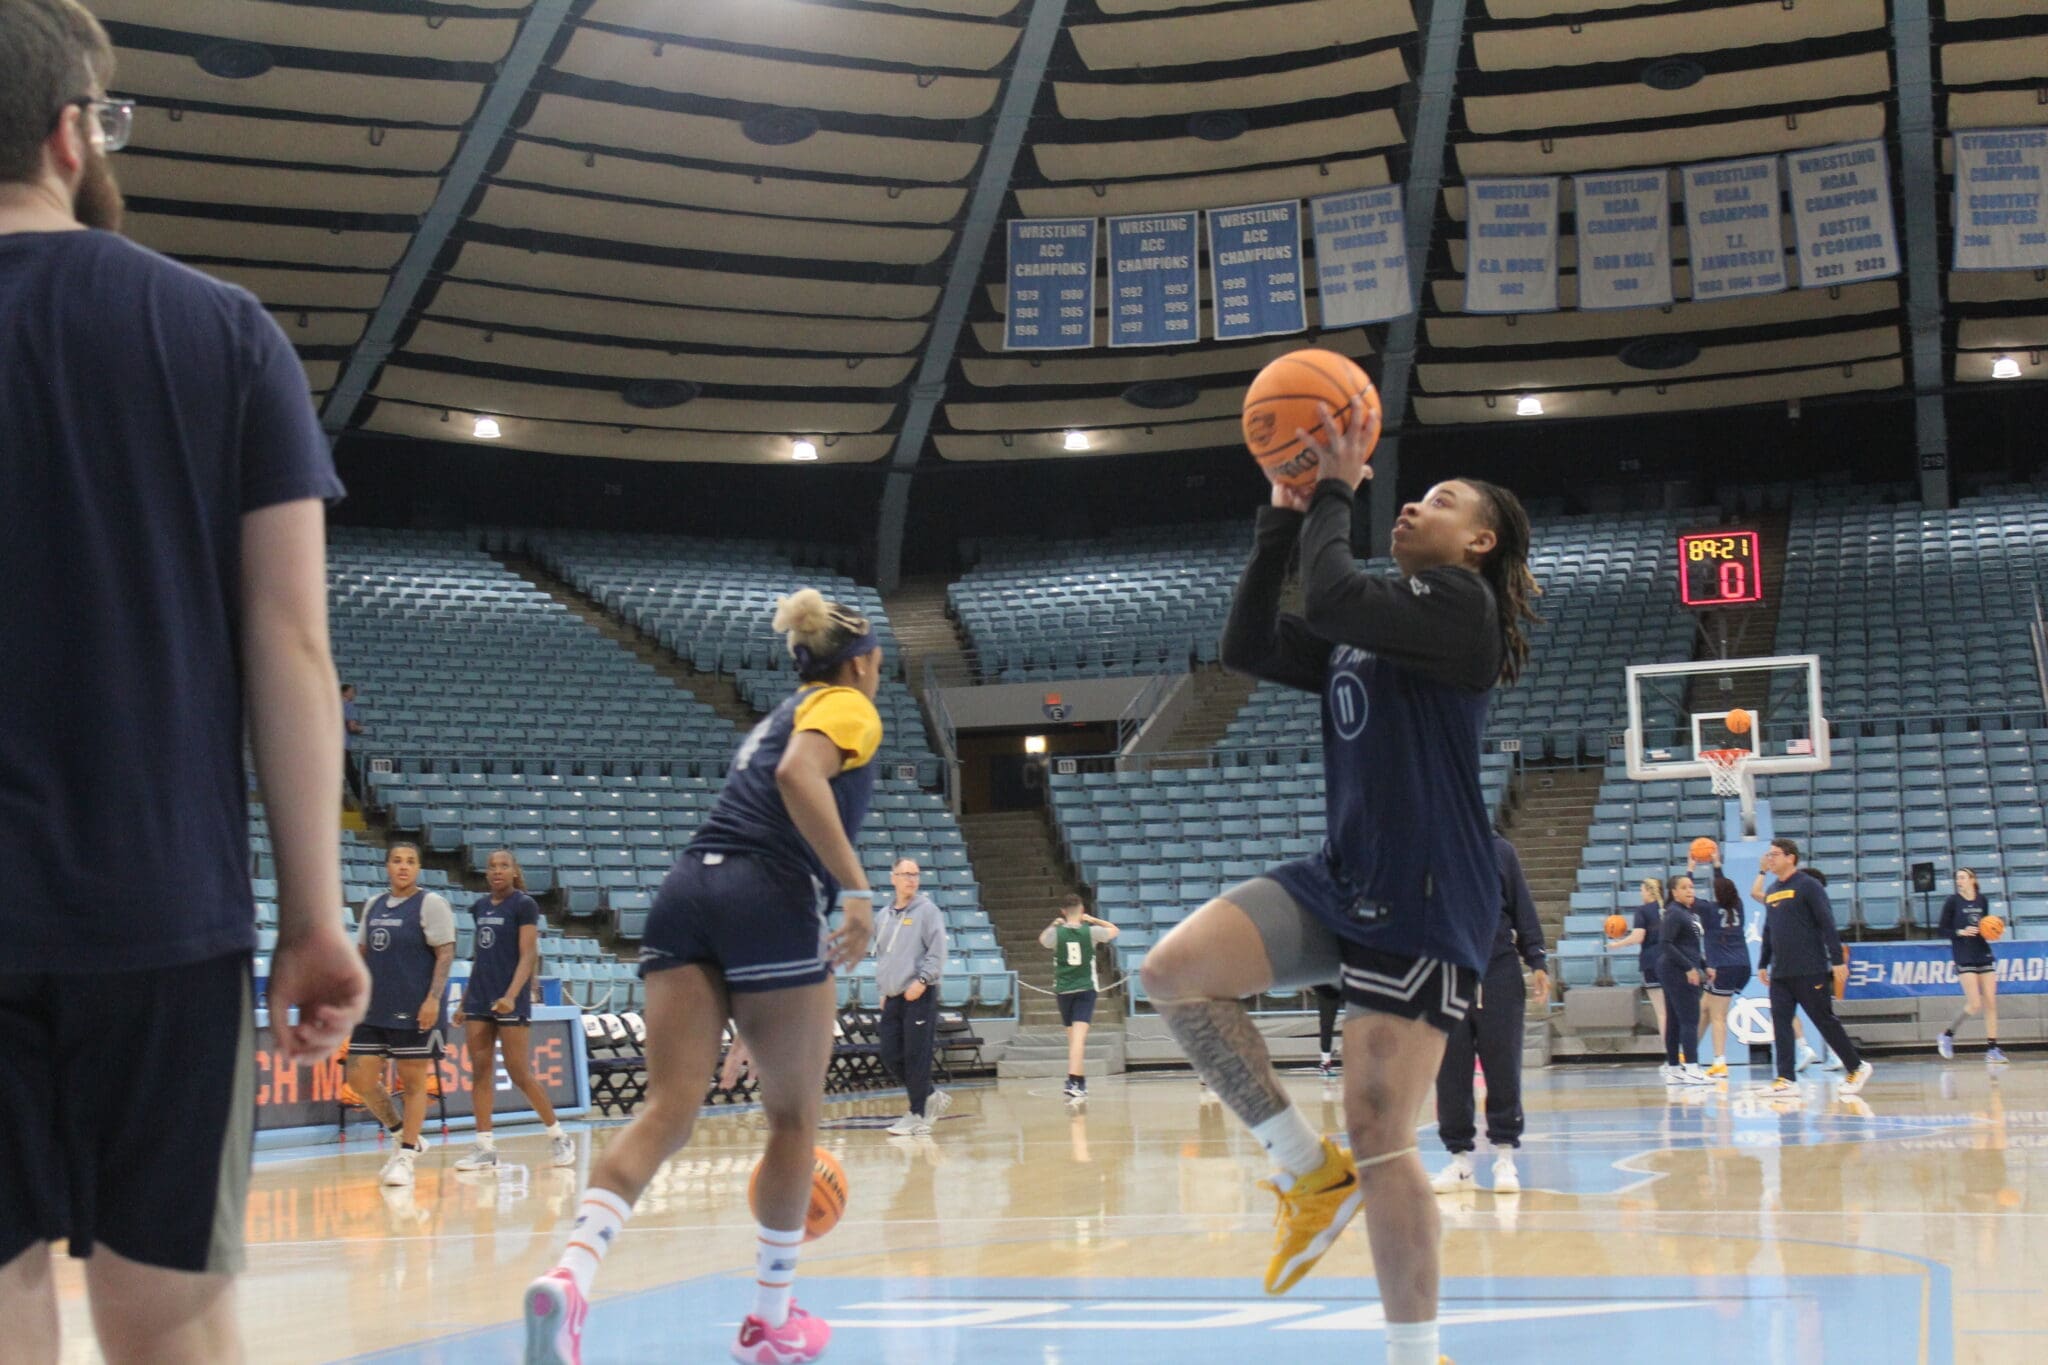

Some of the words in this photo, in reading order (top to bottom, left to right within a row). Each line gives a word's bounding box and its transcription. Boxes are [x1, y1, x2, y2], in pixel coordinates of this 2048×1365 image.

[1797, 148, 1876, 174] WRESTLING
[1692, 164, 1769, 187] WRESTLING
[1820, 171, 1858, 191] NCAA
[1476, 184, 1549, 199] WRESTLING
[1584, 176, 1659, 196] WRESTLING
[1713, 186, 1749, 204] NCAA
[1321, 192, 1393, 215] WRESTLING
[1603, 198, 1640, 214] NCAA
[1805, 187, 1878, 213] CHAMPION
[1219, 208, 1288, 228] WRESTLING
[1495, 203, 1530, 218] NCAA
[1699, 203, 1769, 225] CHAMPION
[1020, 225, 1087, 238] WRESTLING
[1119, 218, 1187, 235] WRESTLING
[1588, 216, 1658, 234] CHAMPION
[1819, 215, 1871, 237] AUSTIN
[1140, 238, 1166, 252] ACC
[1243, 229, 1268, 244] ACC
[1039, 244, 1064, 257] ACC
[1220, 245, 1292, 266] CHAMPIONS
[1015, 262, 1087, 277] CHAMPIONS
[1117, 256, 1189, 272] CHAMPIONS
[1815, 263, 1845, 279] 2021
[1855, 257, 1886, 272] 2023
[1689, 538, 1749, 561] 89:21
[1720, 562, 1745, 599] 0
[1337, 684, 1355, 724] 11
[1066, 941, 1082, 966] 8
[1891, 960, 1958, 985] MARC
